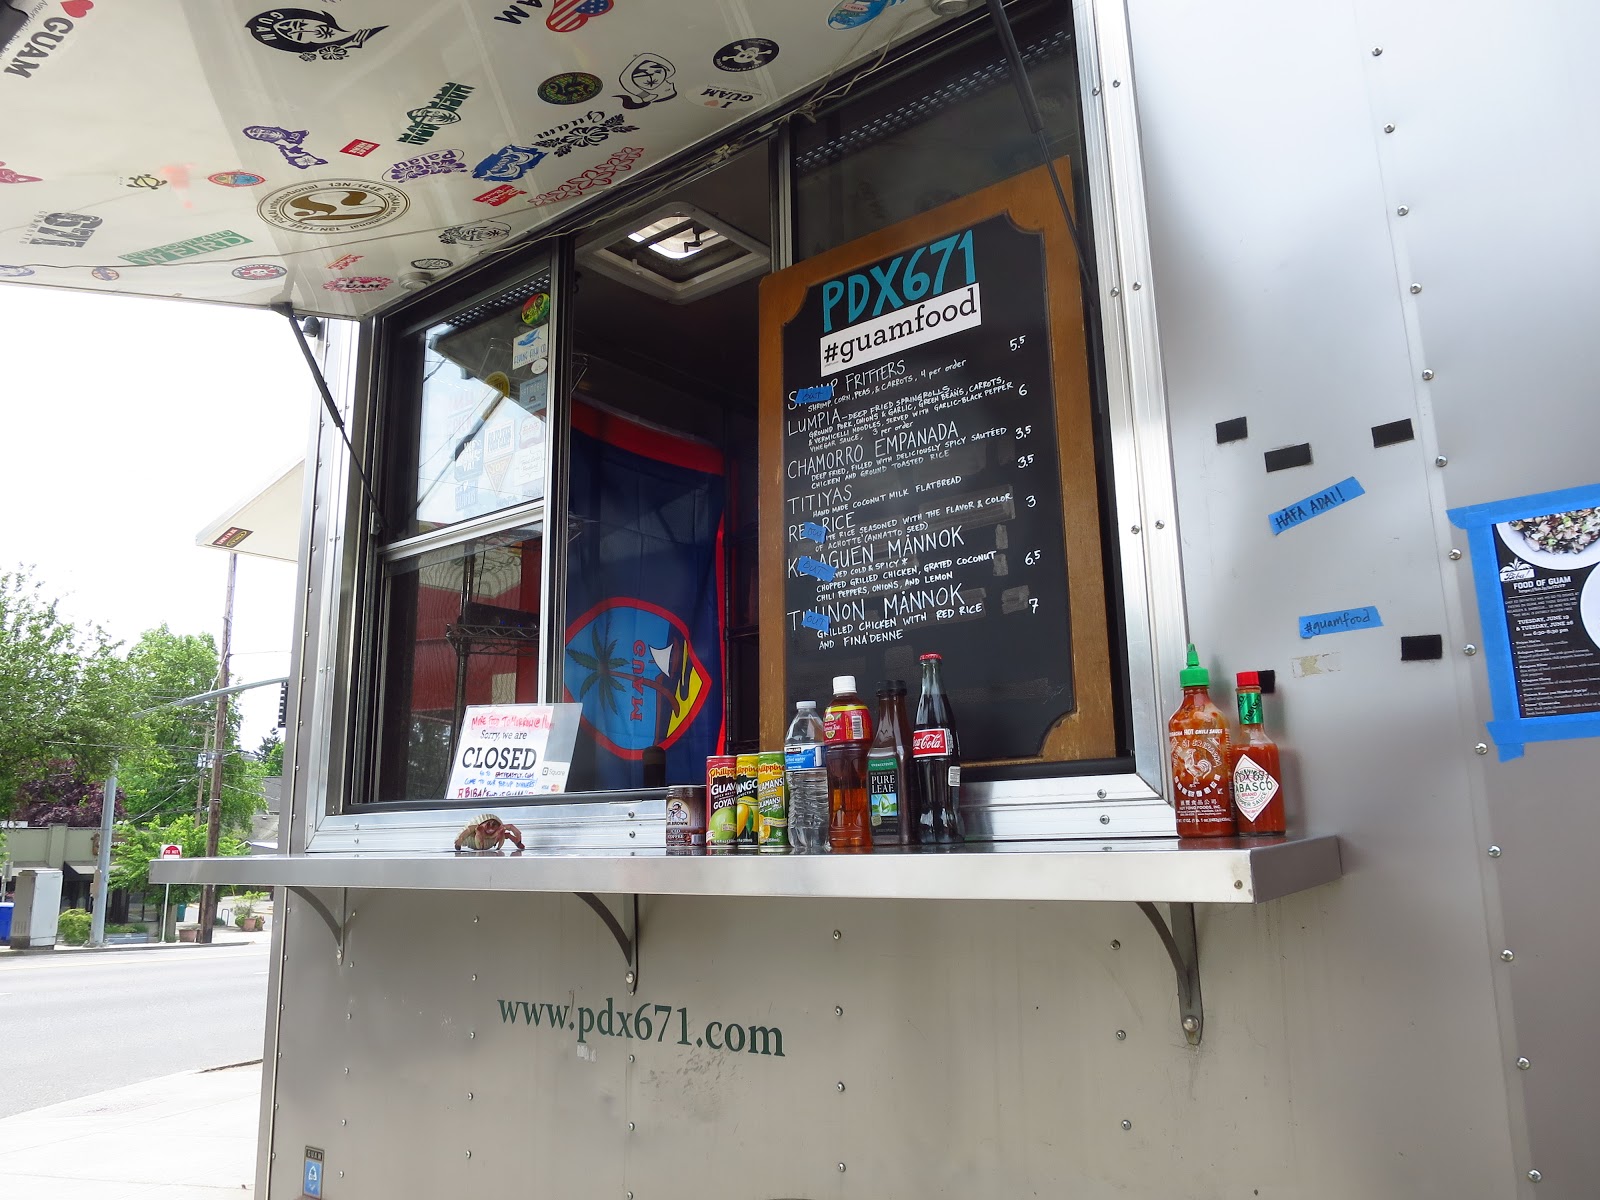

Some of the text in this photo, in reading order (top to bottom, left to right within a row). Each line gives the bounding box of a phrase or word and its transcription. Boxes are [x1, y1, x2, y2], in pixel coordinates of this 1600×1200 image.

[256, 11, 284, 40] GUAM
[4, 17, 74, 78] GUAM
[700, 89, 753, 102] GUAM
[535, 111, 605, 138] Guam
[133, 236, 246, 265] WEIRD
[822, 229, 976, 333] PDX671
[824, 287, 977, 363] #guamfood
[846, 360, 905, 391] FRITTERS
[920, 369, 925, 378] 4
[928, 367, 941, 378] per
[945, 358, 966, 371] order
[1019, 382, 1027, 396] 6
[808, 425, 833, 439] GROUND
[856, 412, 878, 425] ONIONS
[918, 395, 939, 408] GREEN
[814, 428, 850, 444] VERMICELLI
[885, 412, 908, 425] SERVED
[912, 406, 928, 417] WITH
[984, 380, 1013, 397] PEPPER
[870, 401, 893, 414] FRIED
[787, 419, 958, 479] CHAMORRO EMPANADA
[809, 439, 836, 453] VINEGAR
[872, 427, 878, 435] 3
[880, 425, 891, 436] per
[894, 418, 913, 431] order
[811, 471, 826, 481] DEEP
[851, 460, 872, 471] FILLED
[876, 455, 892, 464] WITH
[896, 442, 940, 459] DELICIOUSLY
[944, 436, 965, 447] SPICY
[811, 448, 949, 489] CHICKEN AND GROUND TOASTED RICE
[787, 484, 852, 515] TITIYAS
[812, 474, 962, 517] HAND MADE COCONUT MILK FLATBREAD
[1026, 494, 1036, 508] 3
[822, 512, 855, 532] RICE
[843, 491, 1013, 538] RICE SEASONED WITH THE FLAVOR & COLOR
[815, 544, 823, 552] OF
[864, 526, 902, 543] (ANNATTO
[906, 520, 928, 534] SEED)
[787, 543, 873, 578] KAGUEN
[816, 578, 846, 592] CHOPPED
[850, 572, 878, 585] GRILLED
[924, 558, 953, 571] GRATED
[956, 549, 996, 566] COCONUT
[850, 565, 867, 575] COLD
[816, 591, 835, 602] CHILI
[904, 576, 920, 586] AND
[924, 570, 953, 583] LEMON
[1513, 581, 1534, 590] FOOD
[1548, 576, 1572, 585] GUAM
[787, 597, 865, 632] TINON
[817, 602, 982, 639] GRILLED CHICKEN WITH RED RICE
[1028, 597, 1039, 615] 7
[1304, 608, 1371, 635] #guamfood
[818, 639, 834, 651] AND
[630, 639, 646, 721] GUAM
[480, 730, 500, 741] Sorry,
[462, 747, 537, 770] CLOSED
[711, 782, 736, 795] GUAV
[737, 779, 758, 794] ANGO
[759, 778, 784, 791] LAMANSI
[871, 774, 896, 785] PURE
[1235, 781, 1273, 792] ABASCO
[713, 799, 736, 809] GOYAV
[497, 997, 786, 1057] www.pdx671.com
